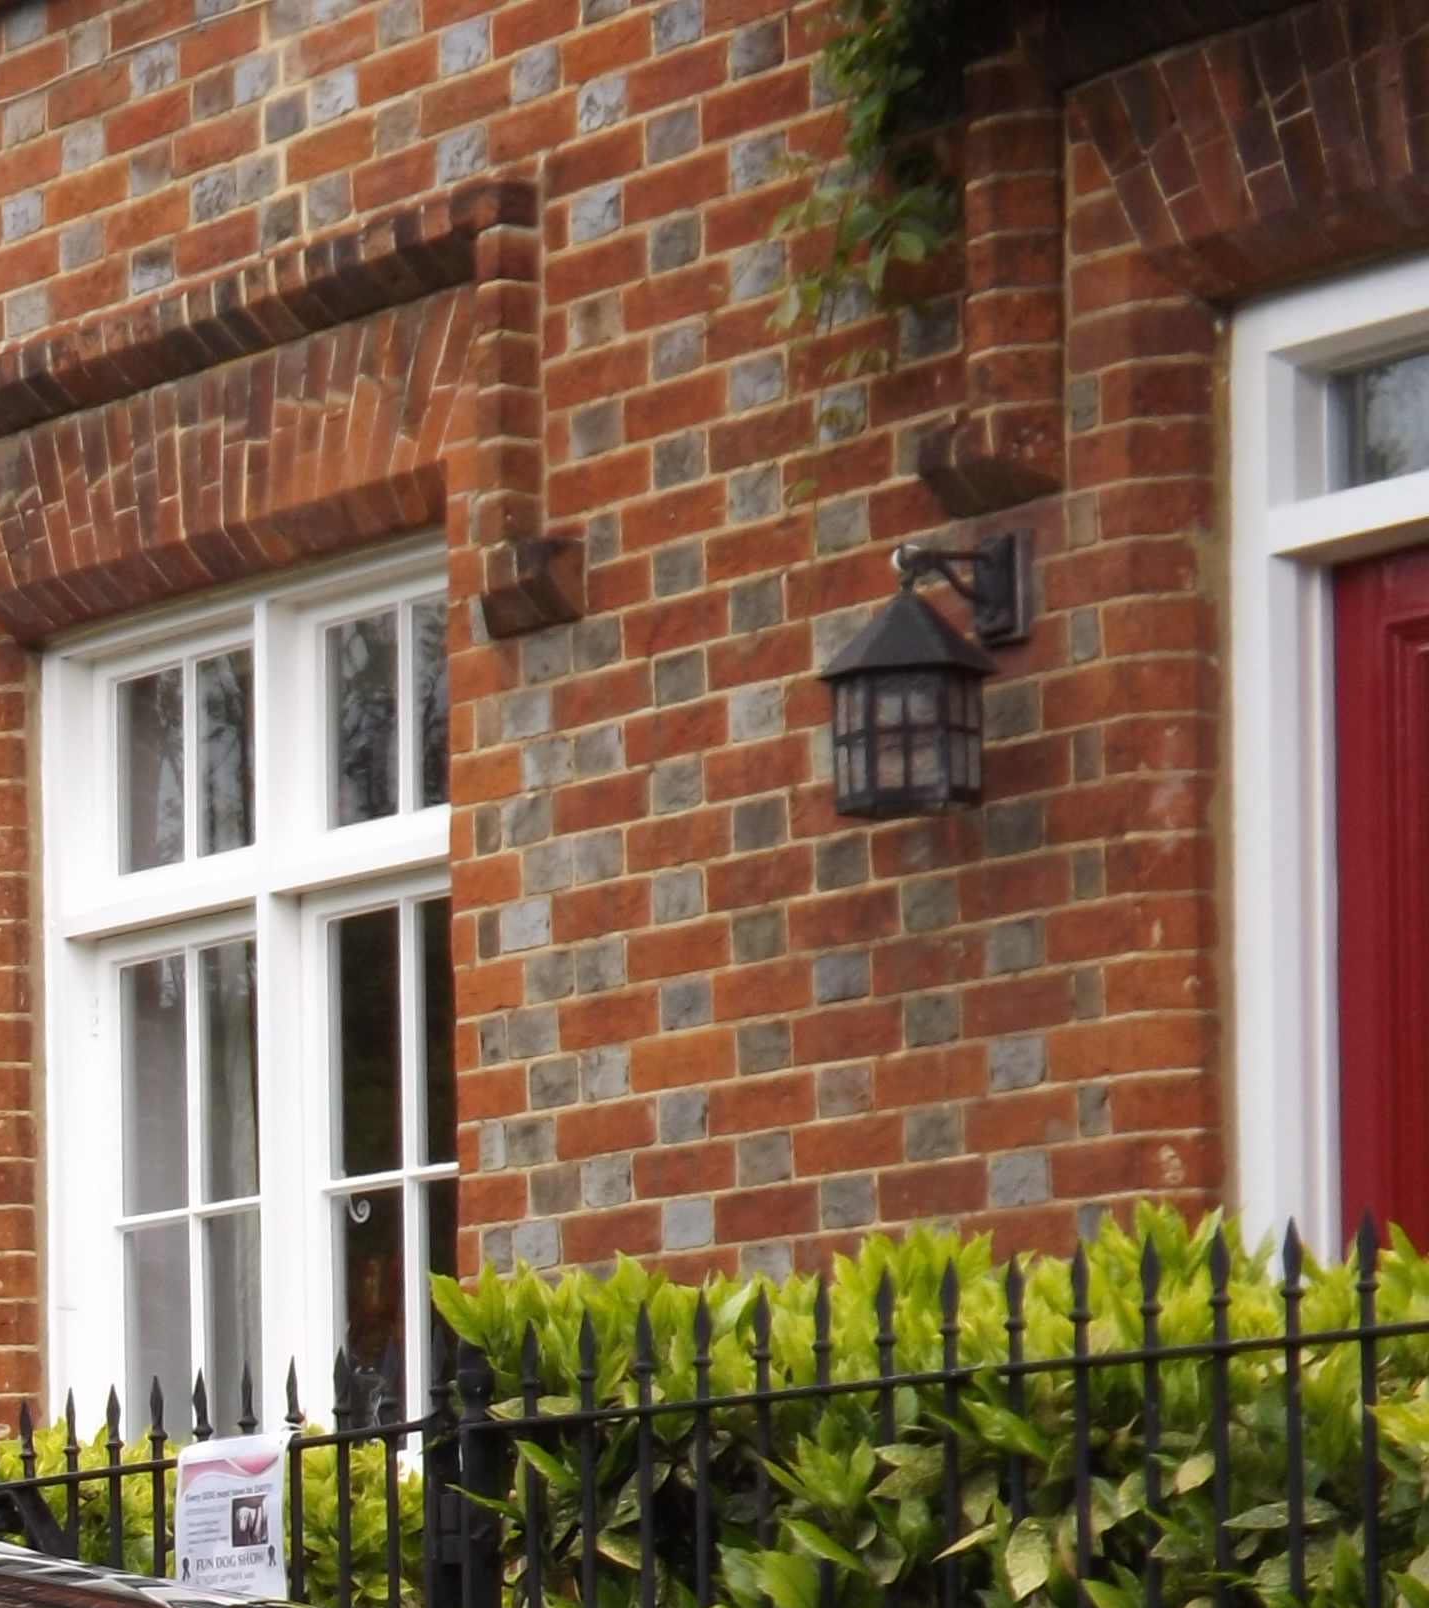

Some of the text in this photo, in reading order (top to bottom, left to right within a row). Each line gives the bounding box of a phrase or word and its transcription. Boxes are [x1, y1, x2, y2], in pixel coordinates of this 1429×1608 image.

[196, 1552, 265, 1571] FUN DOG SHOW
